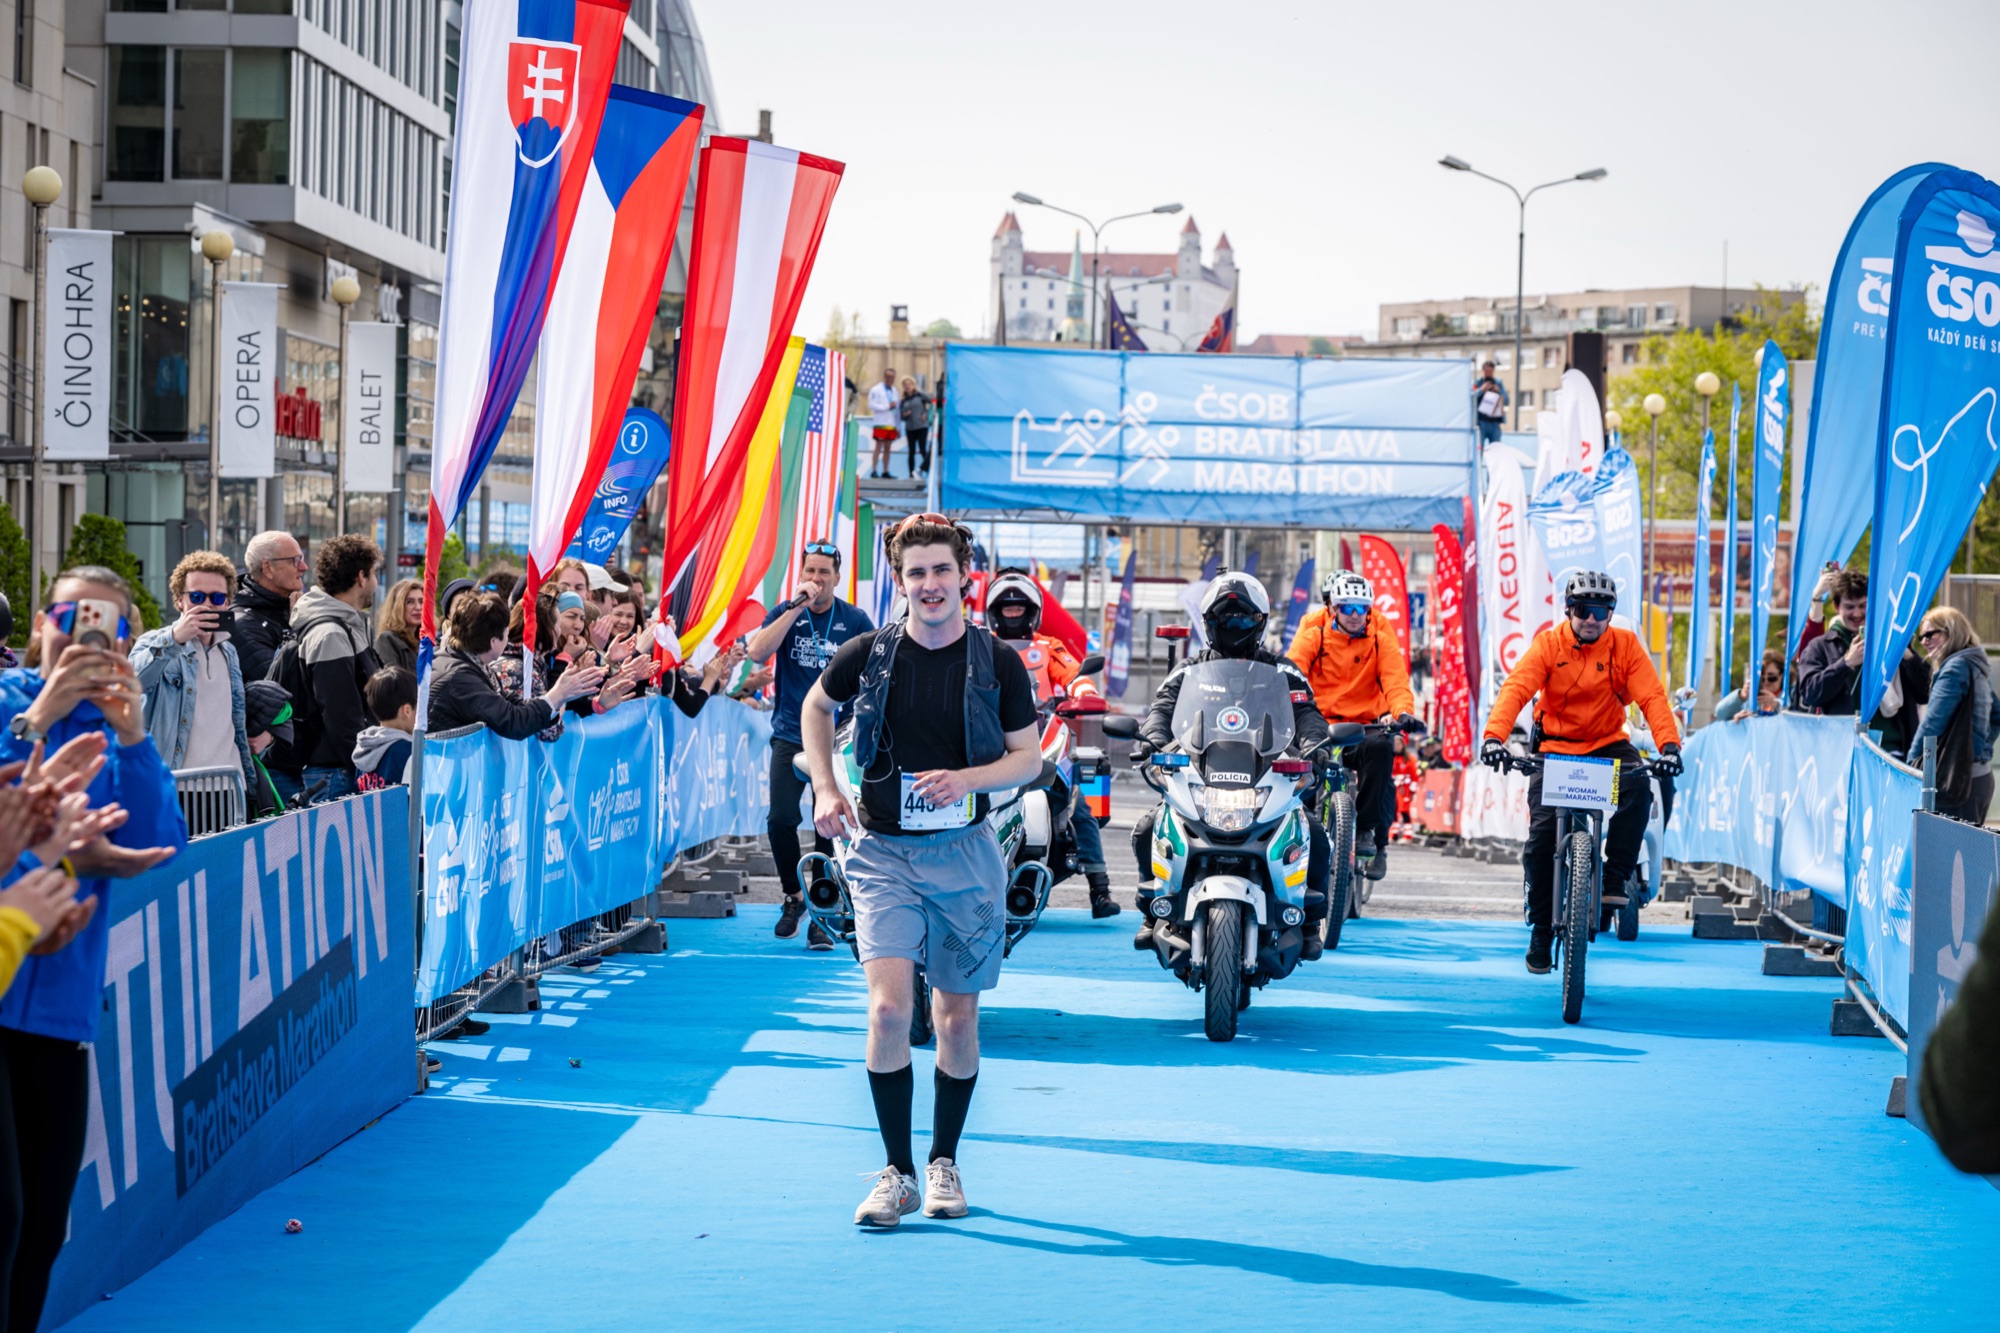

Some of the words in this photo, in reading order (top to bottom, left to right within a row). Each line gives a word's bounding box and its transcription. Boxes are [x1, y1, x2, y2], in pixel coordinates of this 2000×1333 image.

[1853, 321, 1875, 337] PRE
[1928, 327, 1960, 346] KAŽDÝ
[1964, 335, 1986, 351] DEŇ
[55, 261, 94, 428] ČINOHRA
[236, 330, 262, 429] OPERA
[360, 369, 382, 445] BALET
[1194, 385, 1289, 422] ČSOB
[1194, 425, 1400, 459] BRATISLAVA
[1194, 462, 1394, 494] MARATHON
[603, 495, 628, 509] INFO
[586, 531, 616, 549] TEAM
[1211, 772, 1250, 782] POLÍCIA
[1565, 793, 1607, 803] MARATHON
[1567, 786, 1598, 795] WOMAN
[963, 954, 988, 979] UNDER
[182, 1046, 277, 1191] Bratislava
[276, 970, 357, 1090] Marathon
